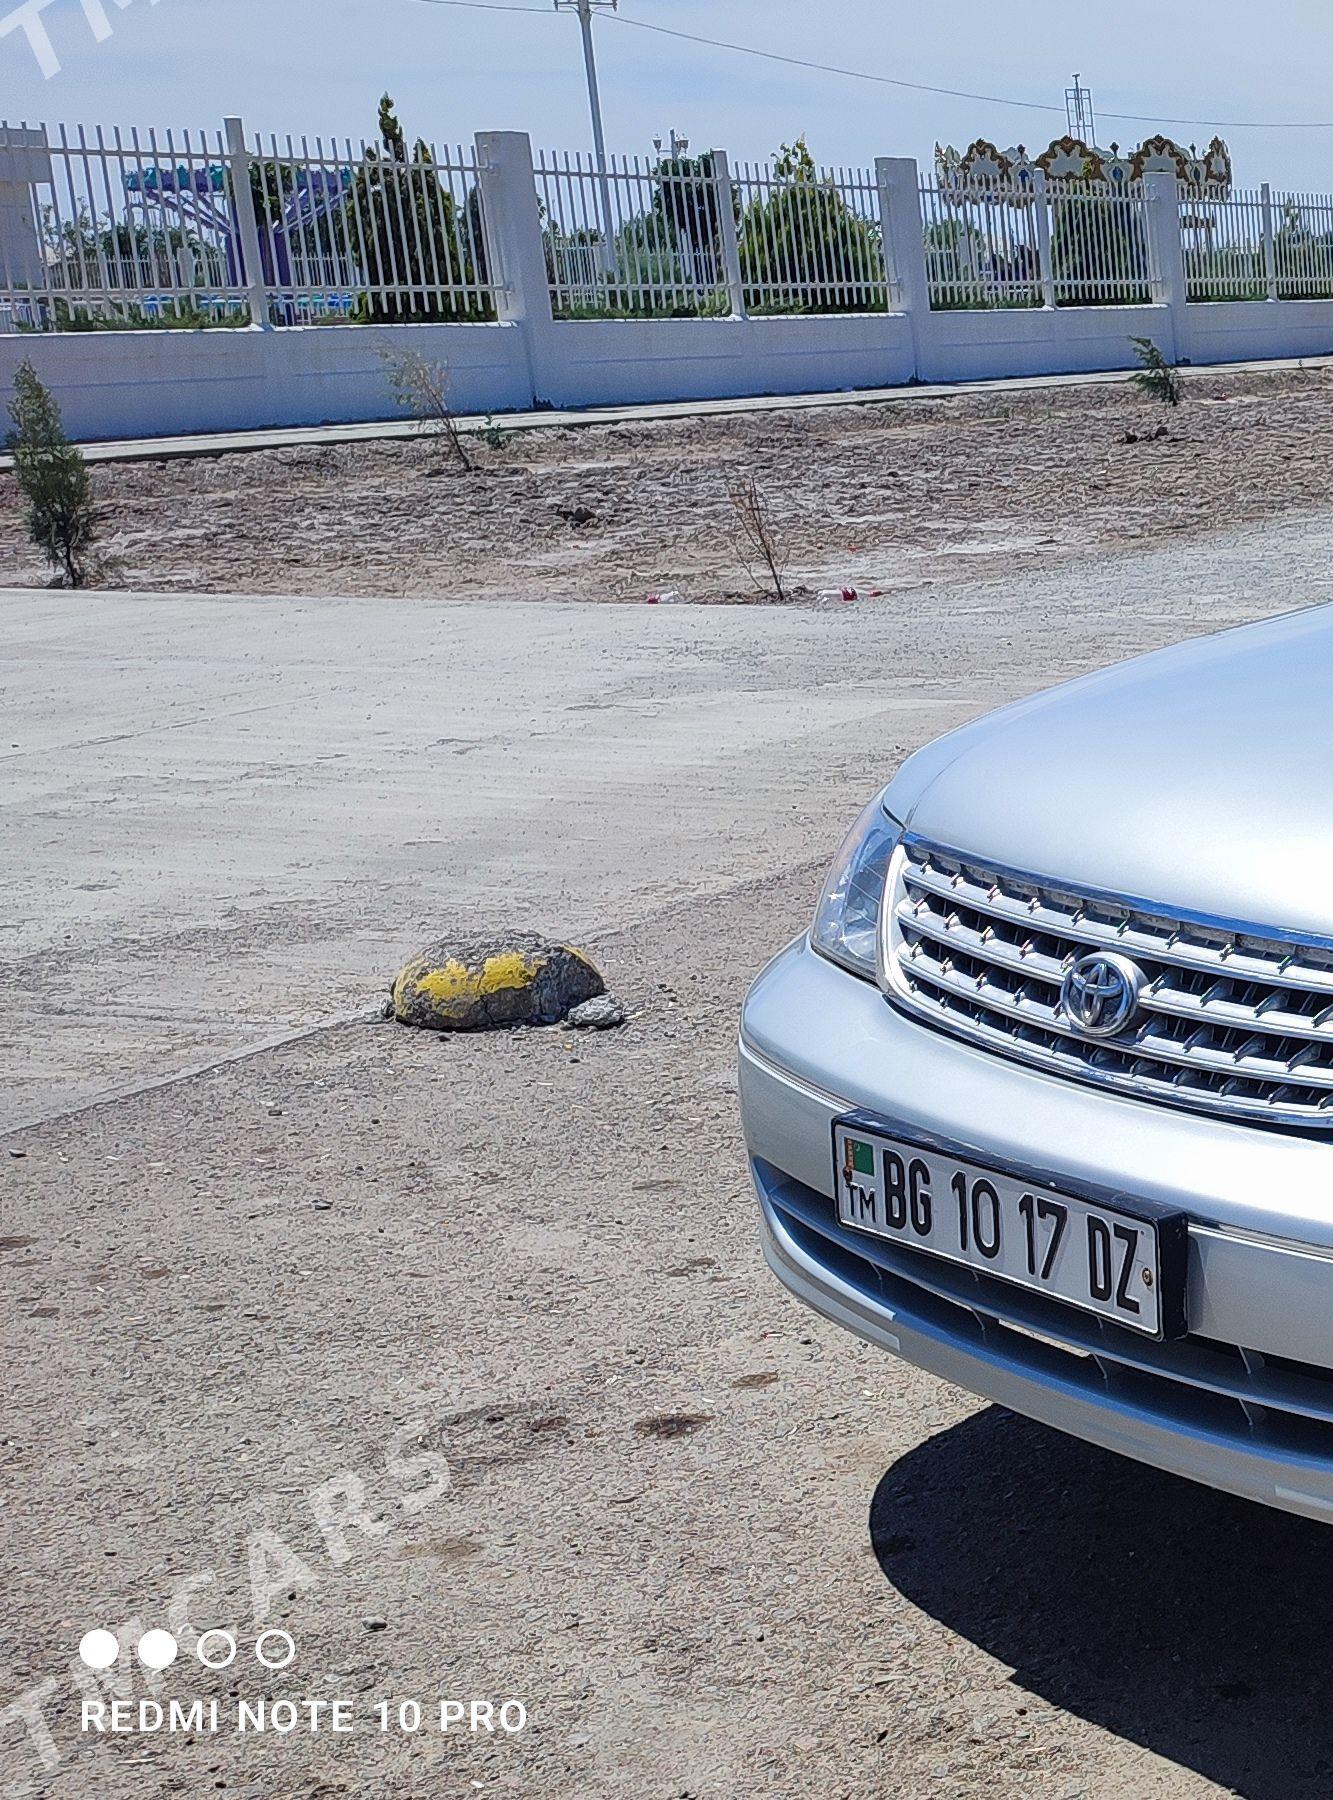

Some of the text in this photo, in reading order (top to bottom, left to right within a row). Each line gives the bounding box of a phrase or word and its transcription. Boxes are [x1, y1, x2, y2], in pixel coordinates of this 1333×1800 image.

[845, 1182, 876, 1224] TM
[882, 1148, 1140, 1314] BG 10 17 DZ
